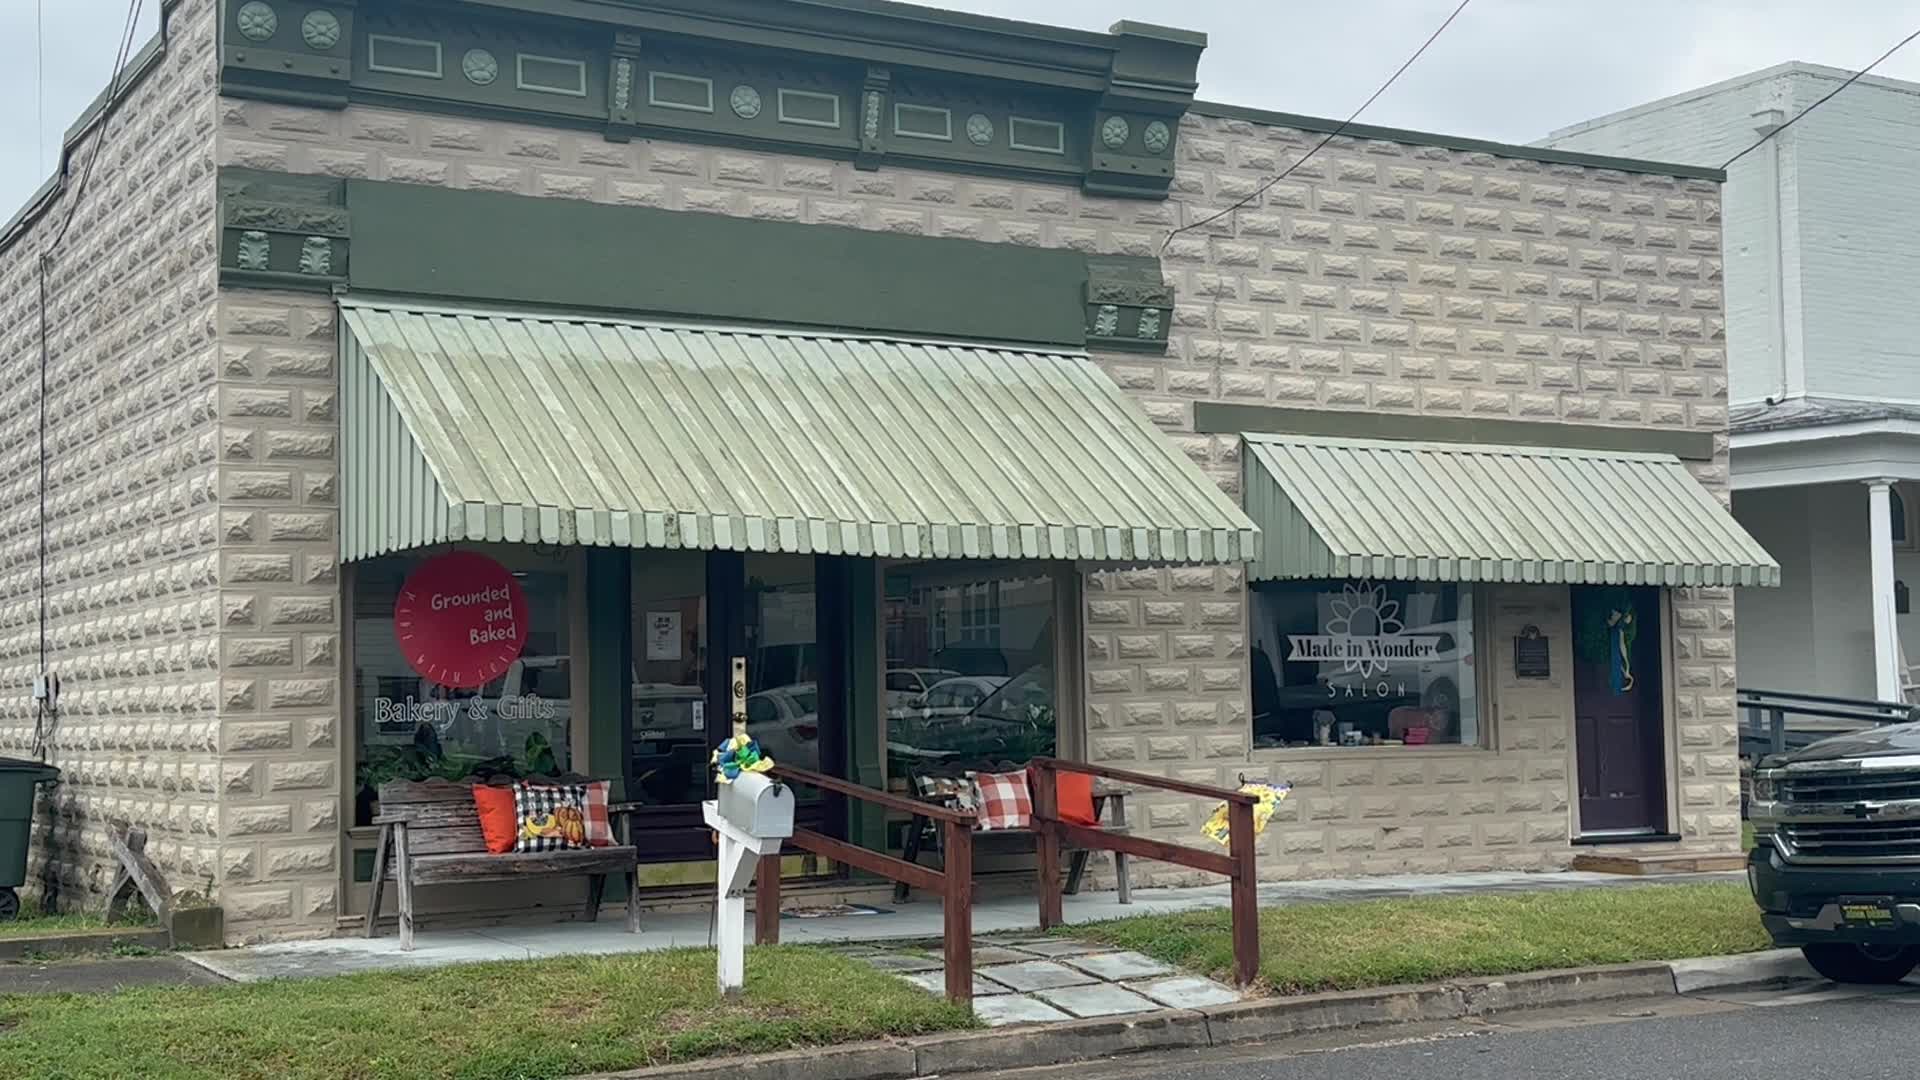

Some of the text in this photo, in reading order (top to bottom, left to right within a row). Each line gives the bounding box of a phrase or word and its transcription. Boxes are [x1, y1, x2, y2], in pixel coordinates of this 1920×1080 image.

[431, 584, 510, 610] Grounded
[484, 603, 513, 622] and
[470, 623, 516, 645] Baked
[1296, 638, 1433, 657] Made in Wonder
[1327, 681, 1405, 698] SALON
[374, 693, 556, 730] Bakery & Gifts
